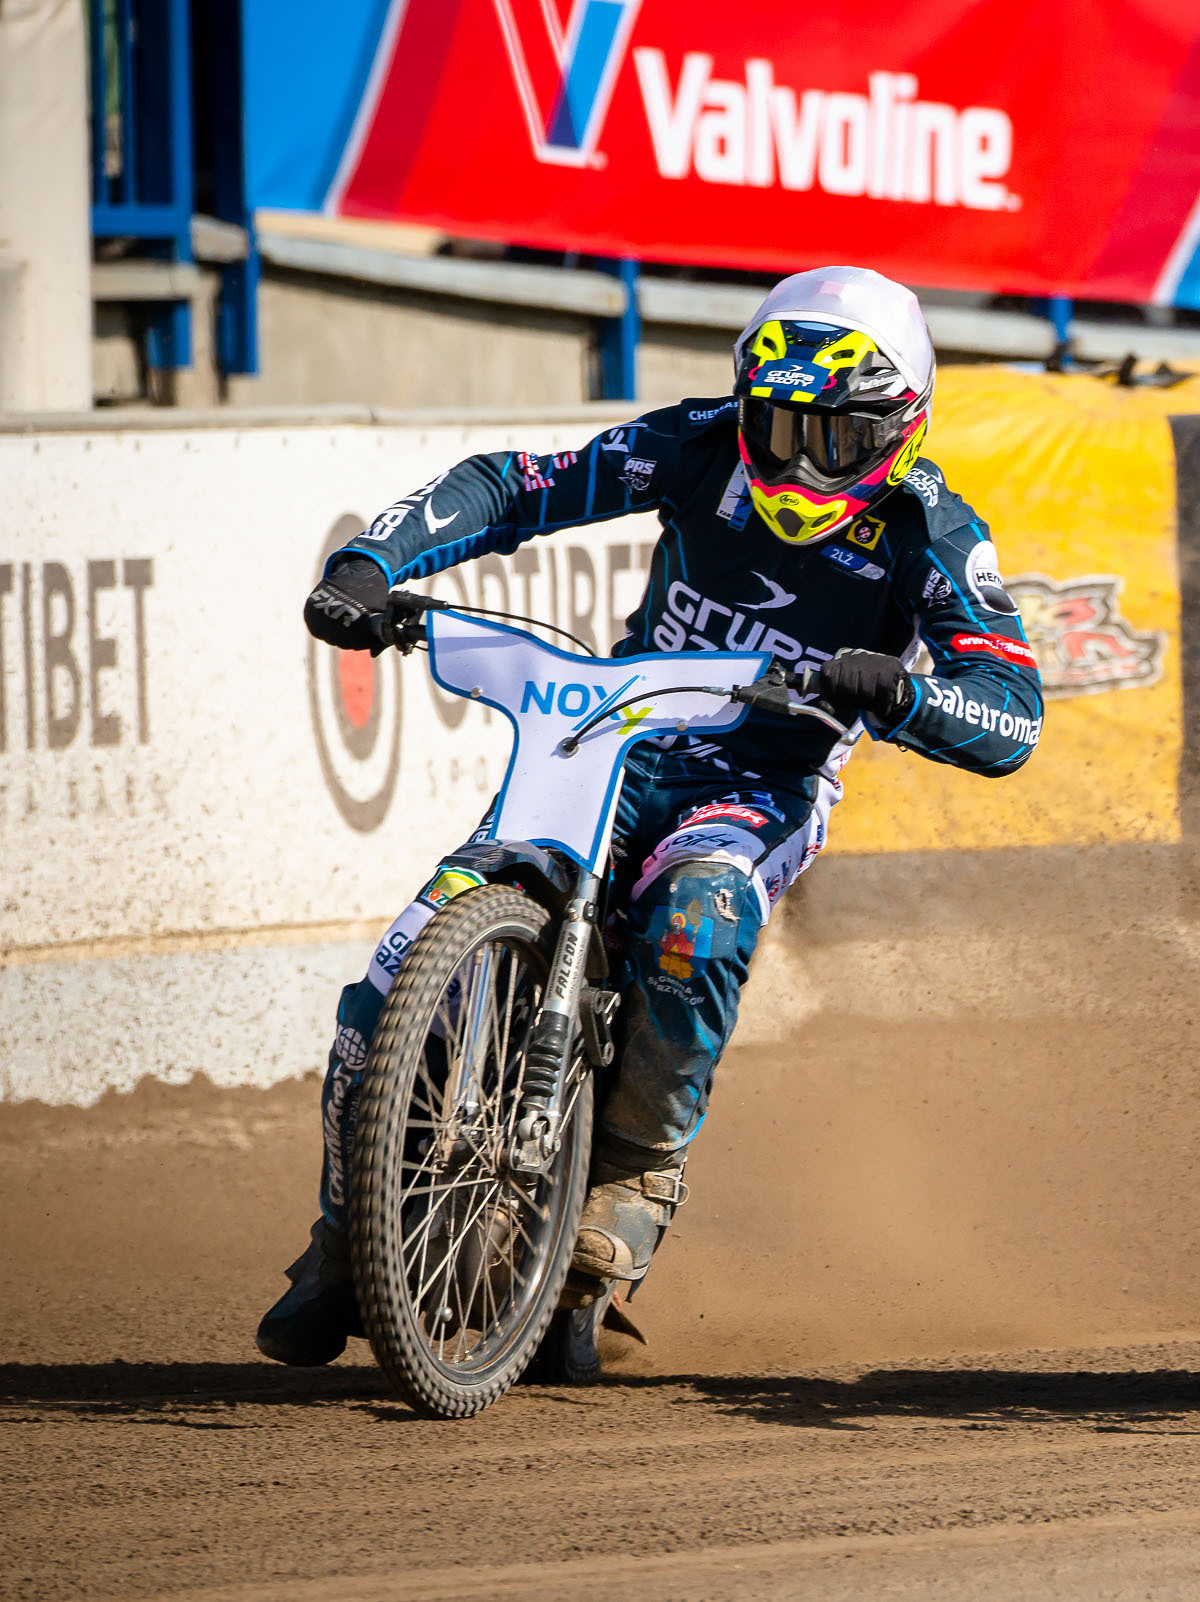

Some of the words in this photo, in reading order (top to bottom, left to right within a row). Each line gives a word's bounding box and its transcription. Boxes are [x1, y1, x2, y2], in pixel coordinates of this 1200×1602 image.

[634, 47, 1013, 210] Valvoline
[424, 543, 657, 730] OPTIBE
[554, 932, 579, 1000] FALCON
